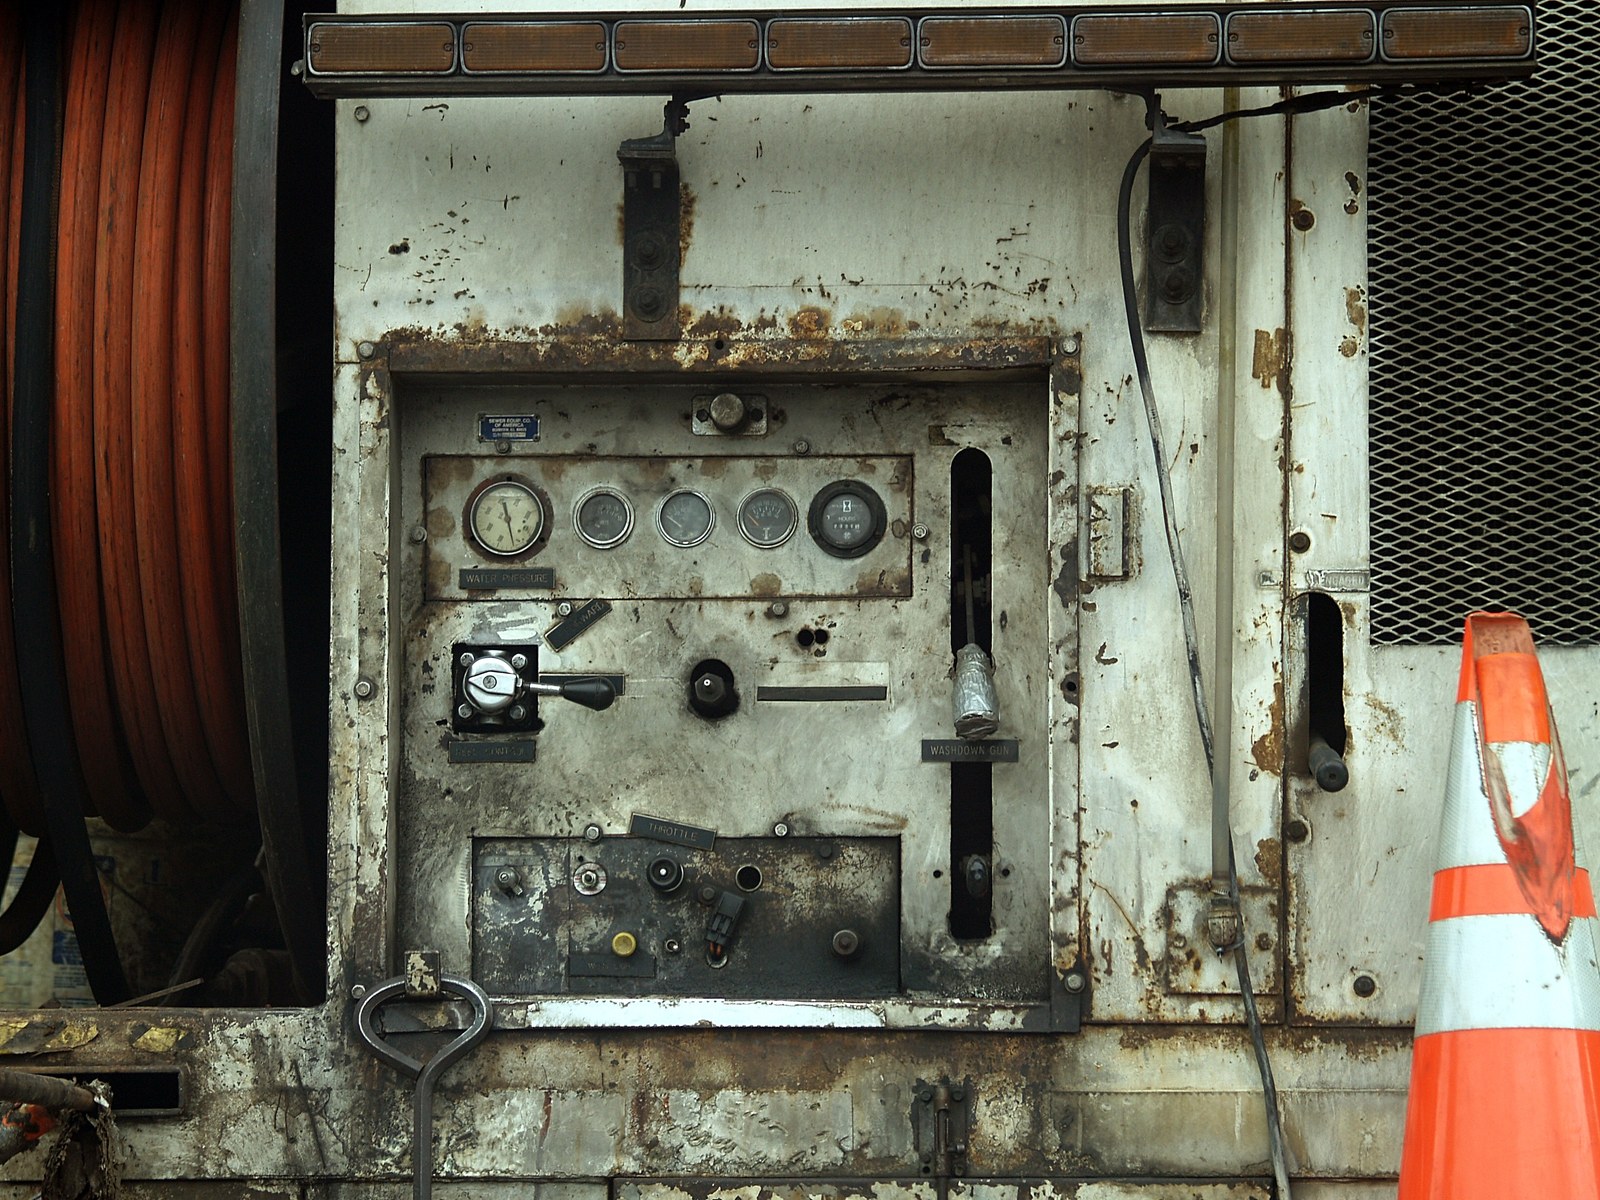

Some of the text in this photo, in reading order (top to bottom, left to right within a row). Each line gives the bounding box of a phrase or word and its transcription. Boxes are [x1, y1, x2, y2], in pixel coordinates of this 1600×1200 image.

[465, 573, 548, 583] WATER PRESSURE
[930, 745, 1009, 756] WASHDOWN GUN
[648, 822, 698, 842] THROTTLE
